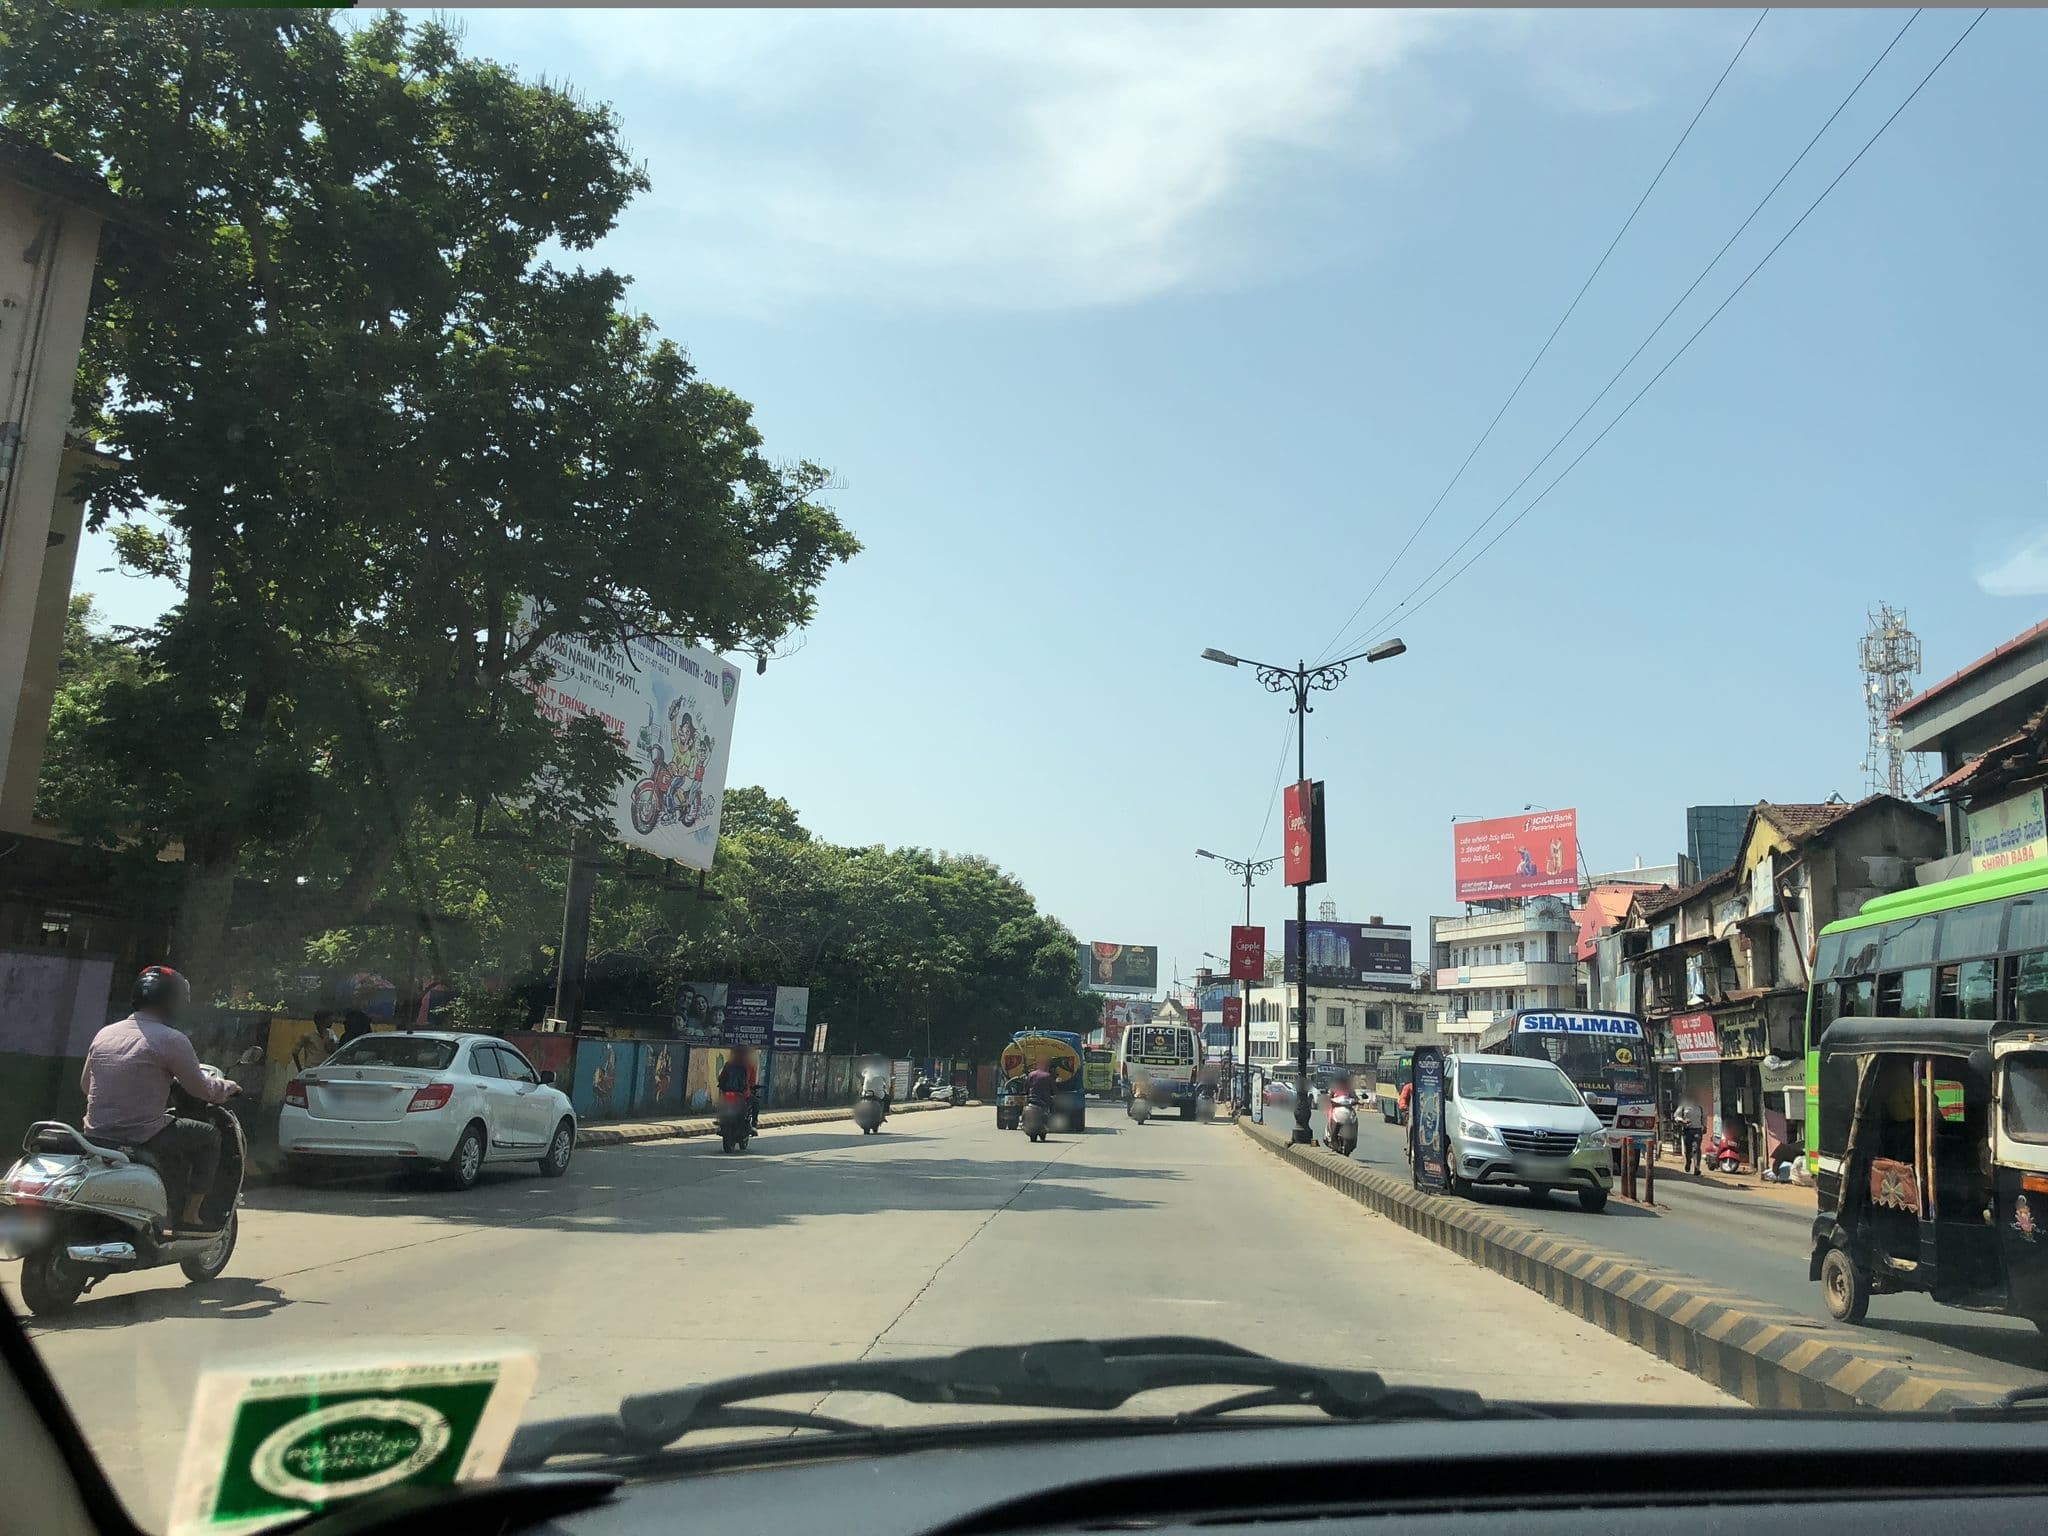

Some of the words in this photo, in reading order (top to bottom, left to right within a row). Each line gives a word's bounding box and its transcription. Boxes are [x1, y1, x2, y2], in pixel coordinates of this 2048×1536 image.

[569, 647, 596, 672] NAHIN
[598, 664, 614, 681] ITNI
[656, 641, 678, 667] SAFETY
[679, 654, 700, 679] MONTH
[704, 669, 719, 689] 2018
[558, 692, 588, 714] DRINK
[600, 711, 625, 737] DRIVE
[1531, 823, 1555, 832] Personal
[1556, 821, 1573, 829] Loans
[1532, 815, 1553, 826] ICICI
[1553, 814, 1573, 823] Bank
[1524, 1016, 1638, 1035] SHALIMAR
[1676, 1033, 1694, 1050] SHOE
[1694, 1031, 1717, 1048] BAZAR
